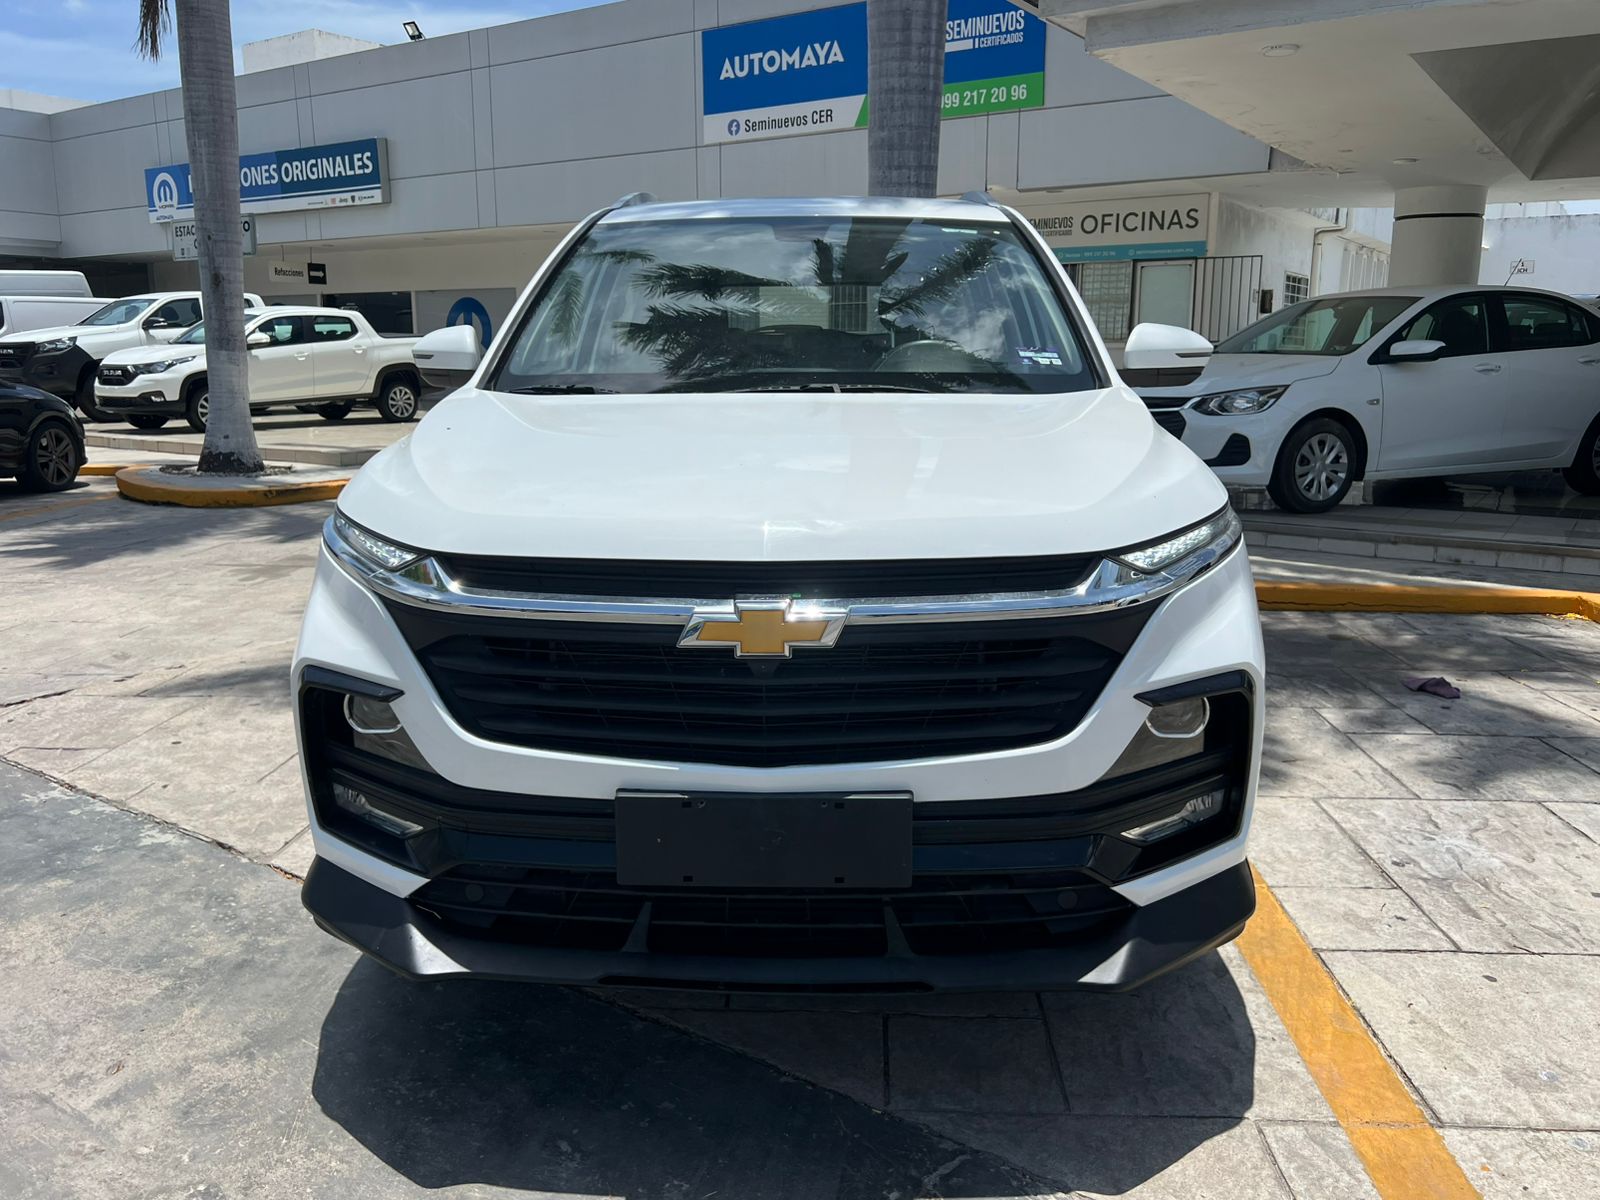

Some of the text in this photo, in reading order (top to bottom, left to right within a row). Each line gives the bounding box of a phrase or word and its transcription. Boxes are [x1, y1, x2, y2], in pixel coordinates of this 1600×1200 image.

[945, 10, 1024, 40] SEMINUEVOS
[980, 32, 1023, 48] CERTIFICADOS
[719, 40, 845, 80] AUTOMAYA
[963, 89, 987, 106] 217
[991, 86, 1007, 103] 20
[1010, 84, 1027, 100] 96
[744, 109, 833, 133] Seminuevos CER
[281, 152, 373, 183] ORIGINALES
[175, 225, 196, 237] ESTAC
[1028, 216, 1074, 230] EMINUEVOS
[1080, 208, 1199, 235] OFICINAS
